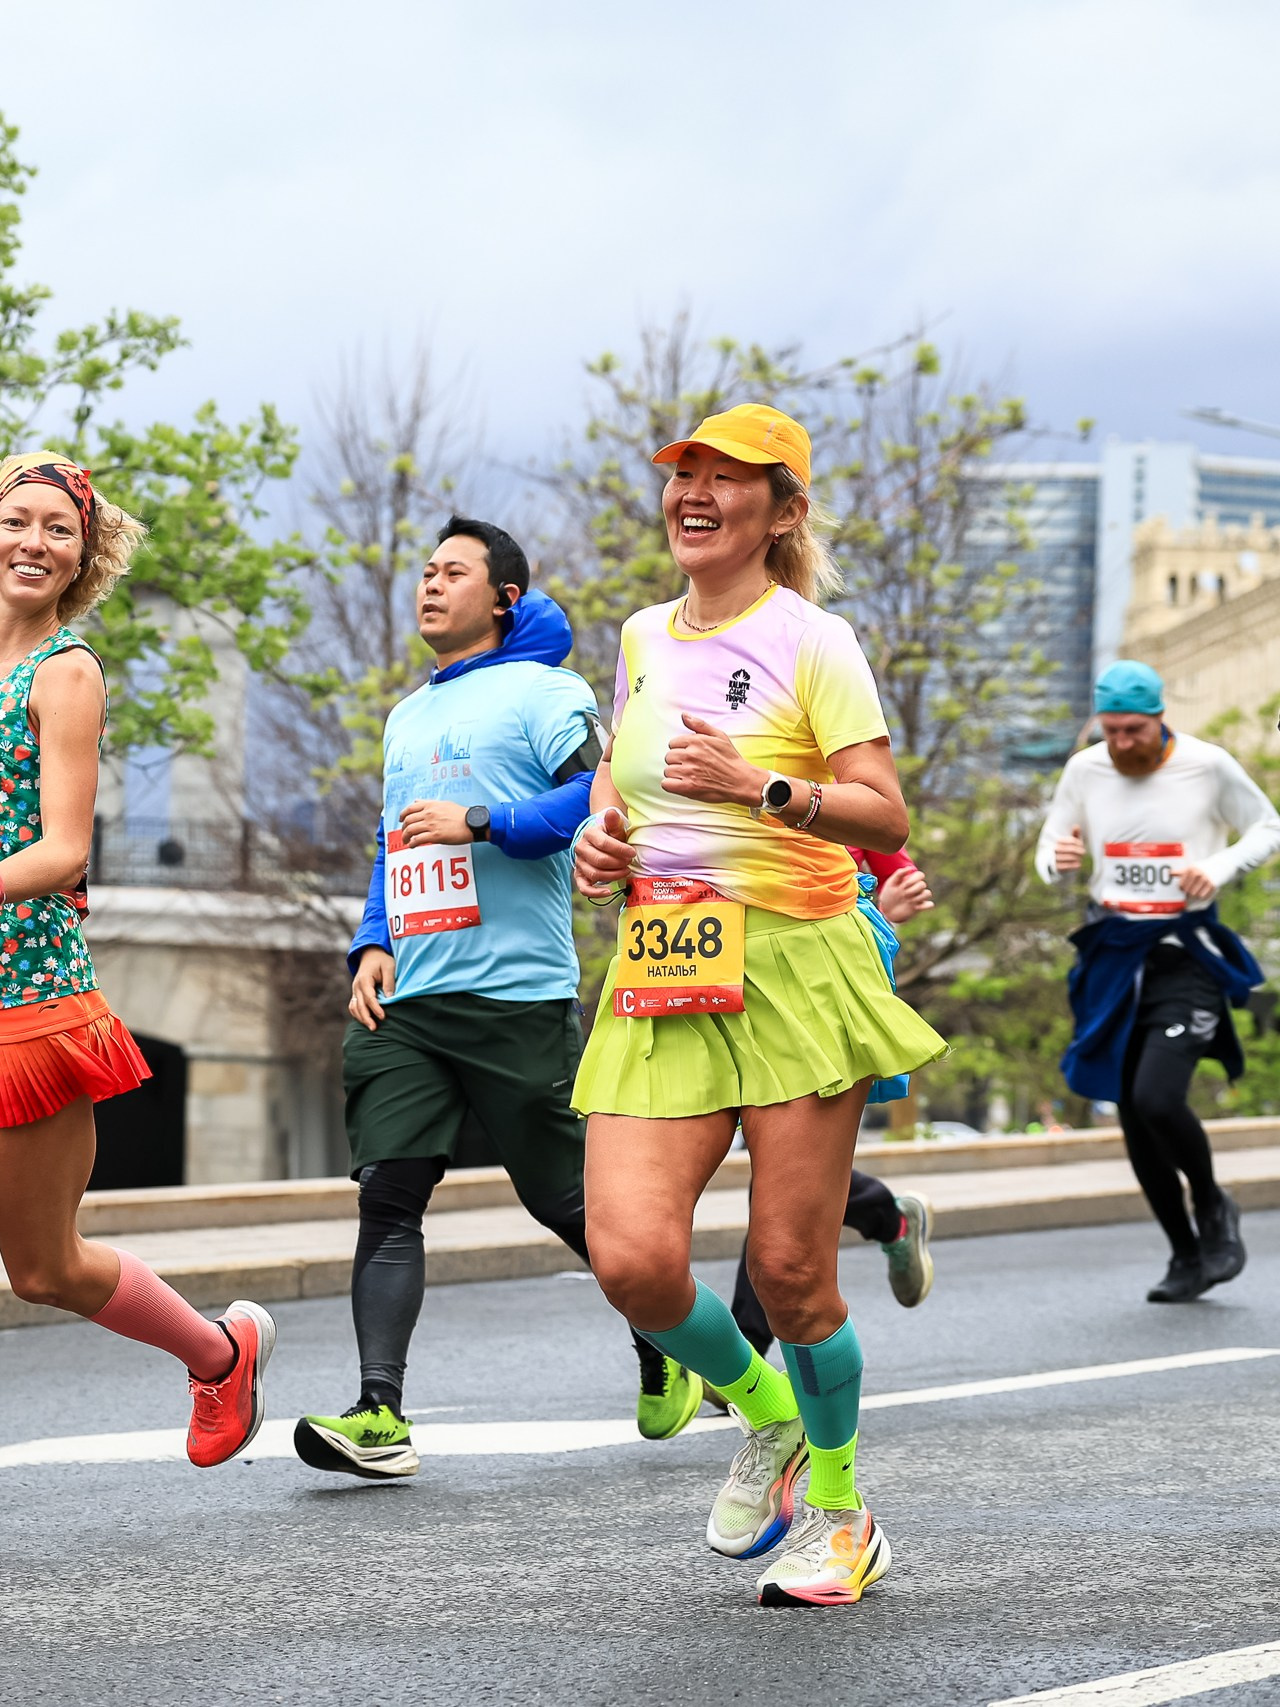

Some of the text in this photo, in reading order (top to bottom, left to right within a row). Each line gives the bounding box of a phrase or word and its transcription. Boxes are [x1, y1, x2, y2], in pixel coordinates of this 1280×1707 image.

[390, 856, 470, 899] 18115
[1114, 864, 1173, 886] 3800
[394, 915, 401, 932] D
[627, 916, 723, 961] 3348
[647, 964, 697, 977] НАТАЛЬЯ
[622, 990, 636, 1013] C
